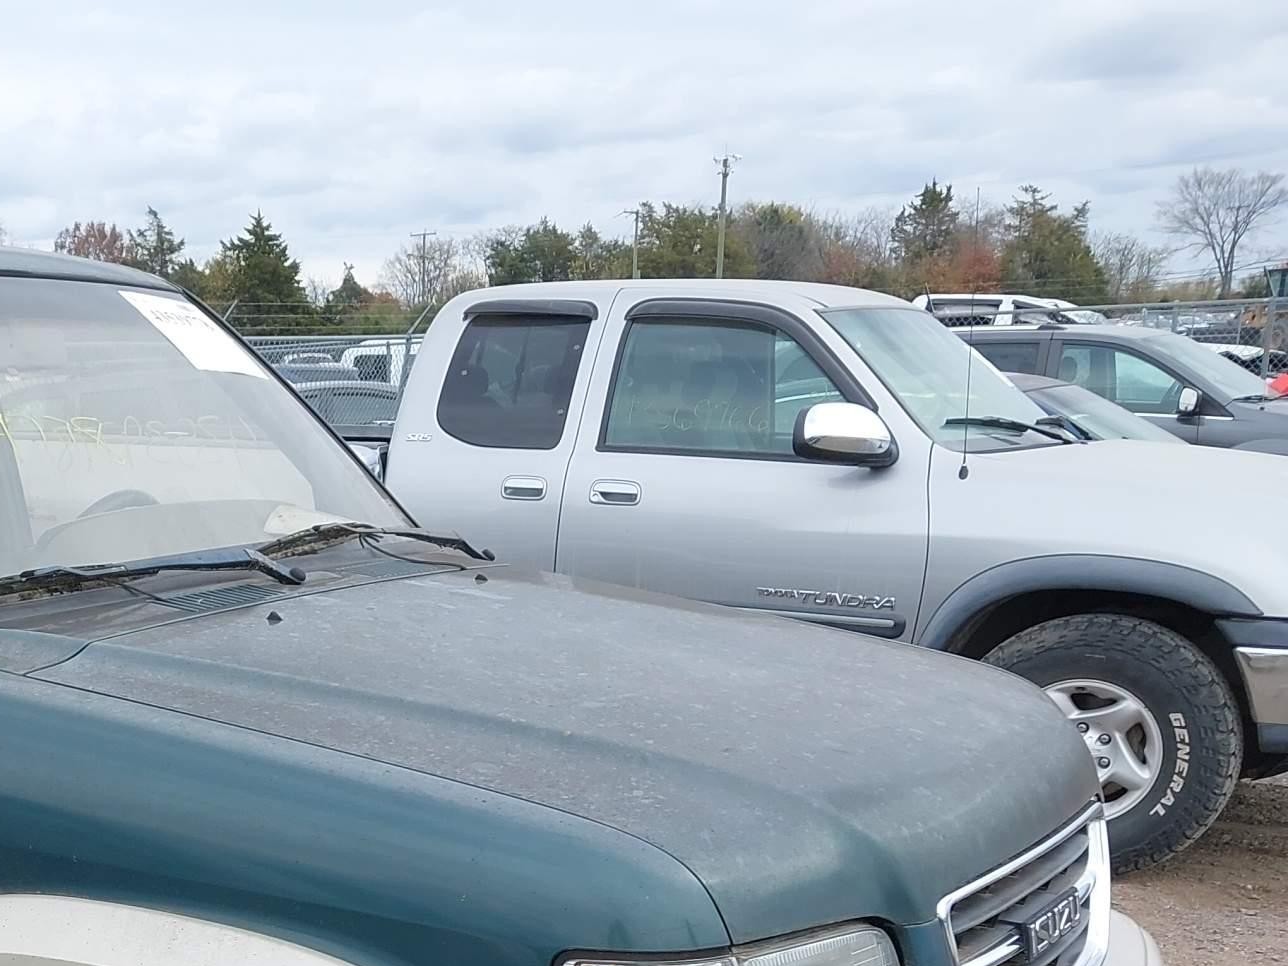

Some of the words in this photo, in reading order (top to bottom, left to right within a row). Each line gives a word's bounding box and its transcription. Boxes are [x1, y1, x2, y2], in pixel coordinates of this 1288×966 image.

[798, 589, 896, 610] TUNDRA
[1149, 713, 1190, 817] GENERAL
[1029, 892, 1080, 957] ISUZU
